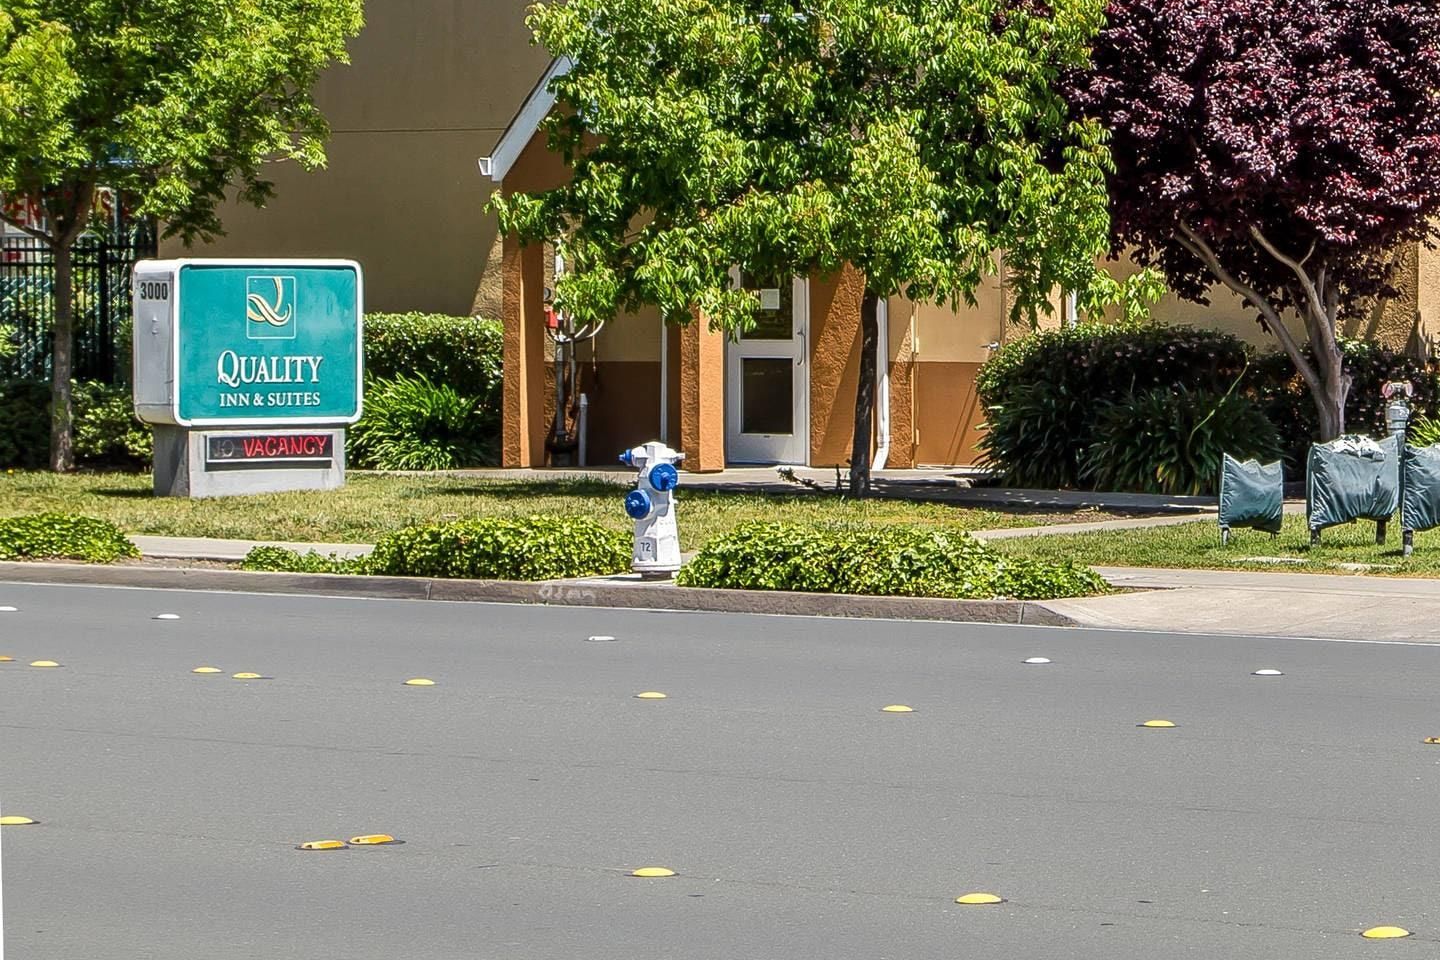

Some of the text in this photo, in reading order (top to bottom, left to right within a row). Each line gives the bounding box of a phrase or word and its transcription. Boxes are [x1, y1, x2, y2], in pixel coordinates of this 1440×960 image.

[140, 281, 168, 300] 3000
[217, 350, 323, 388] QUALITY
[219, 392, 321, 408] INN & SUITES
[243, 436, 328, 457] VACANCY
[640, 542, 651, 552] 72
